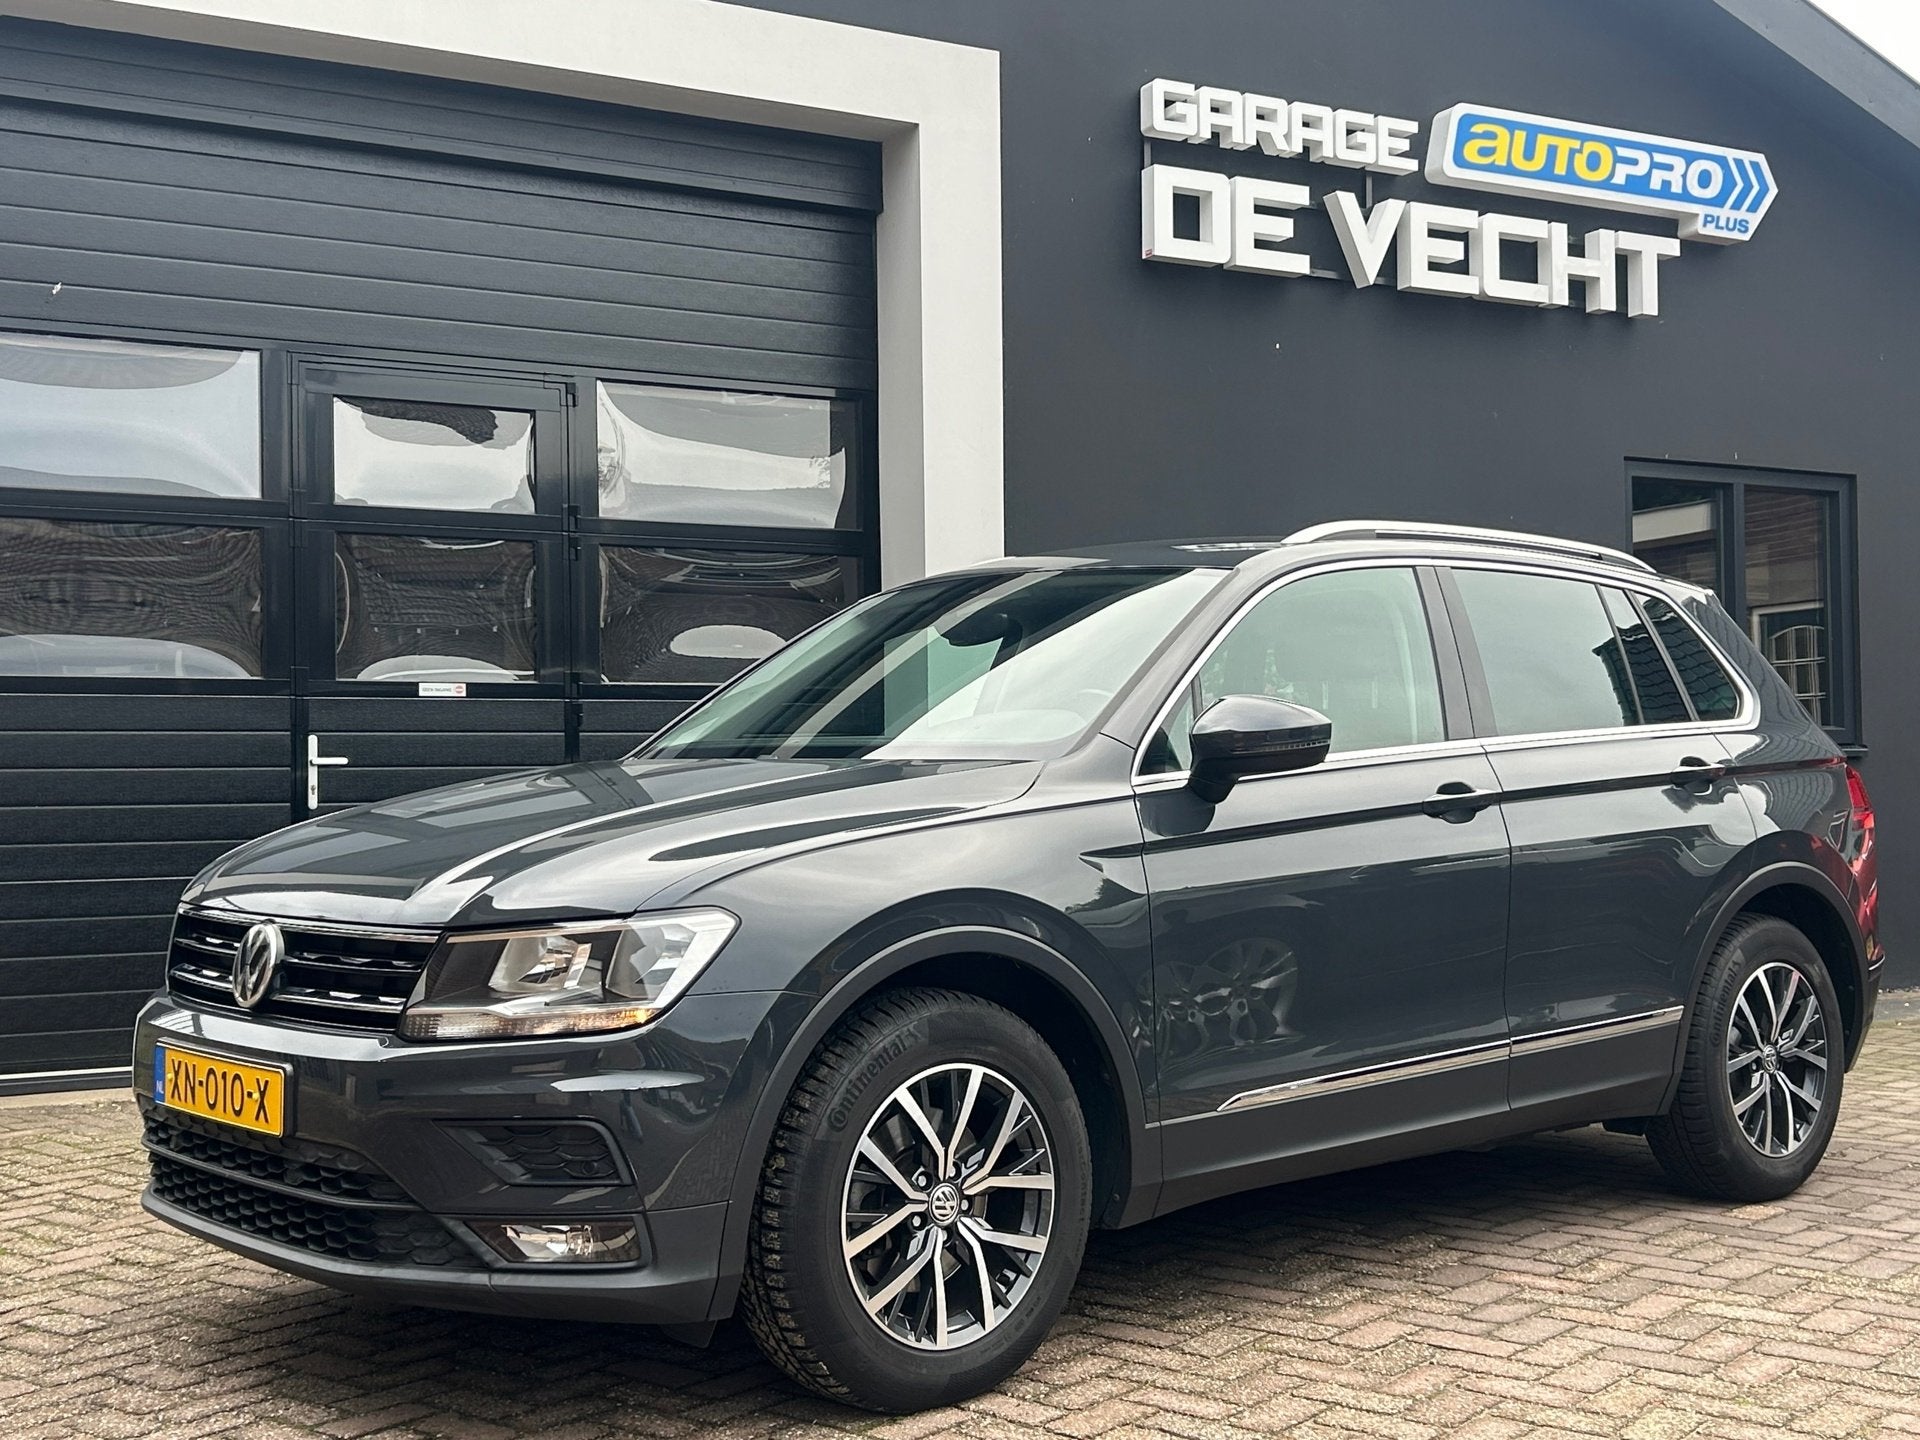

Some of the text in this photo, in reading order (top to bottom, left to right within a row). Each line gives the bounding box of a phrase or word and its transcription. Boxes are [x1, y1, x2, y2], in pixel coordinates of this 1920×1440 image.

[1142, 78, 1419, 176] GARAGE
[1142, 163, 1680, 318] DE VECHT
[1703, 213, 1749, 235] PLUS
[171, 1058, 270, 1124] XN-010-X
[827, 1034, 907, 1132] Continental
